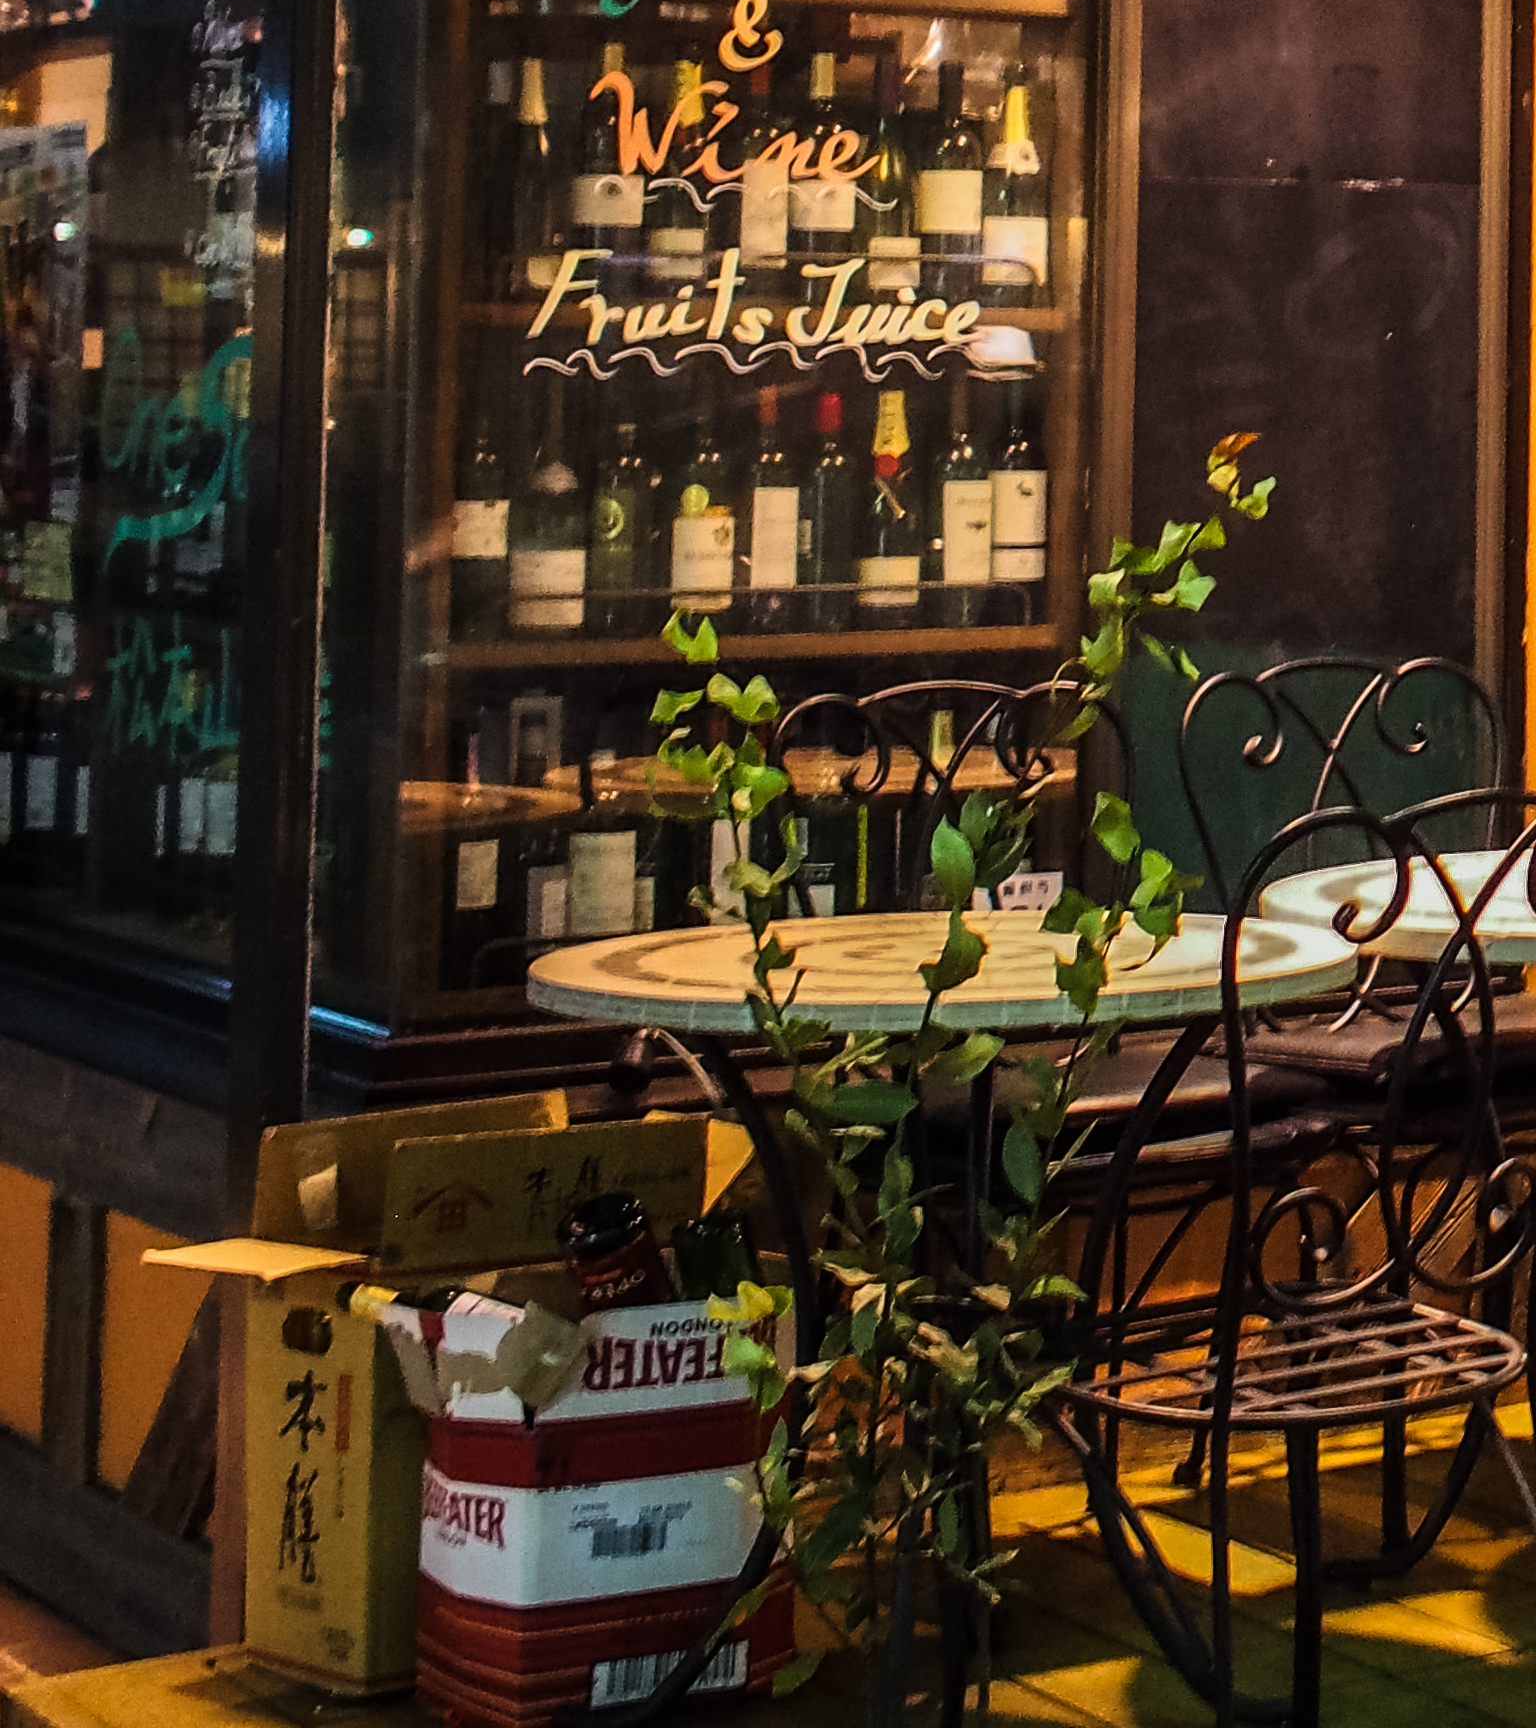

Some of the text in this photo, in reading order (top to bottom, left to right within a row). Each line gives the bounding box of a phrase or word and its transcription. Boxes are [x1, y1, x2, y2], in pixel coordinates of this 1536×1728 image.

[590, 70, 881, 183] Wine
[526, 247, 987, 347] Fruits Juice
